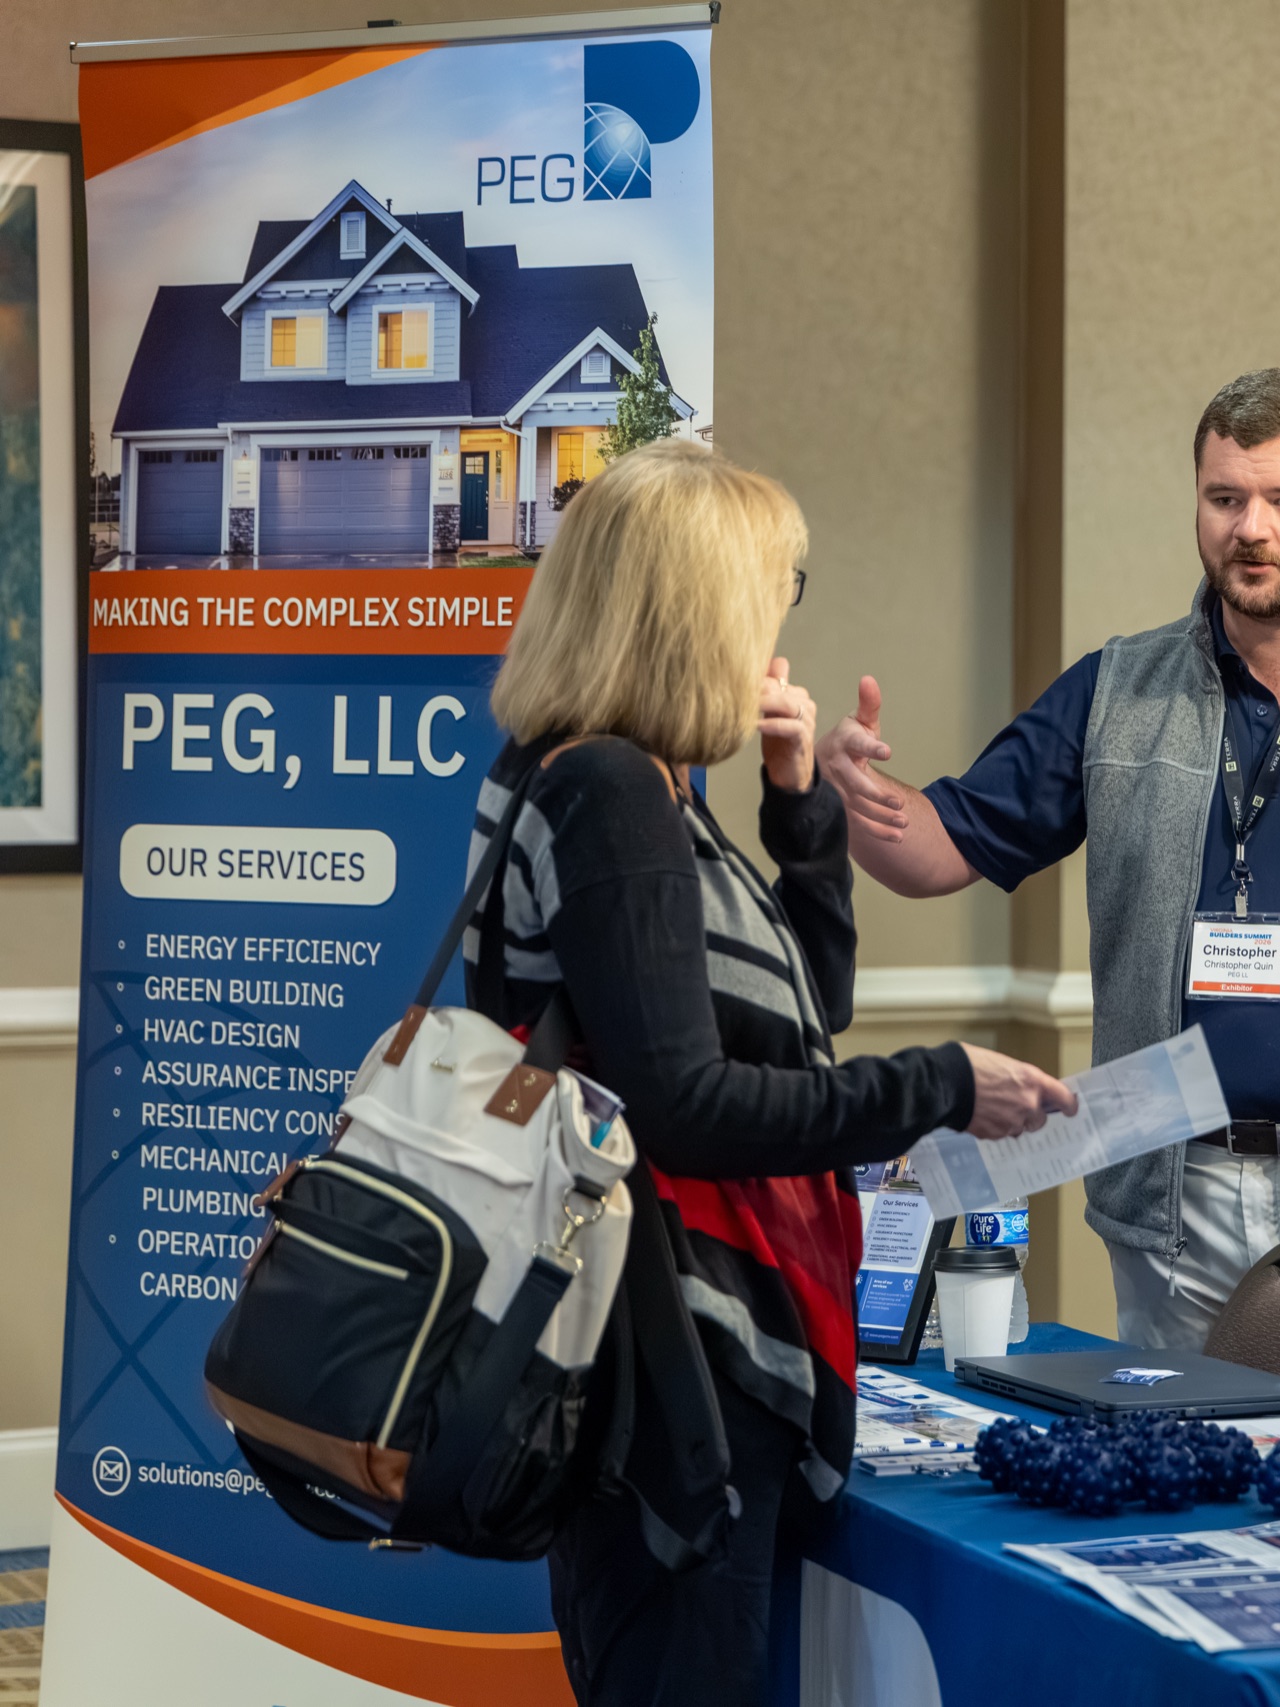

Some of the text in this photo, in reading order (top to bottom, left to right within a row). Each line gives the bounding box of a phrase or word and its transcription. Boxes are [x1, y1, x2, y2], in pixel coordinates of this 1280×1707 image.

[477, 153, 575, 206] PEG
[93, 596, 514, 628] MAKING THE COMPLEX SIMPLE
[122, 692, 468, 790] PEG, LLC
[1223, 736, 1232, 762] TERRA
[1242, 808, 1259, 832] TERRA
[146, 846, 366, 883] OUR SERVICES
[145, 933, 382, 967] ENERGY EFFICIENCY
[1203, 945, 1277, 959] Christopher
[1204, 960, 1273, 970] Christopher Quin
[144, 975, 345, 1008] GREEN BUILDING
[1221, 984, 1253, 992] Exhibitor
[143, 1018, 300, 1049] HVAC DESIGN
[141, 1060, 281, 1090] ASSURANCE
[141, 1102, 280, 1133] RESILIENCY
[142, 1186, 266, 1218] PLUMBING
[894, 1200, 919, 1208] Services
[973, 1214, 995, 1224] Pure
[975, 1223, 992, 1236] Life
[139, 1271, 238, 1302] CARBON
